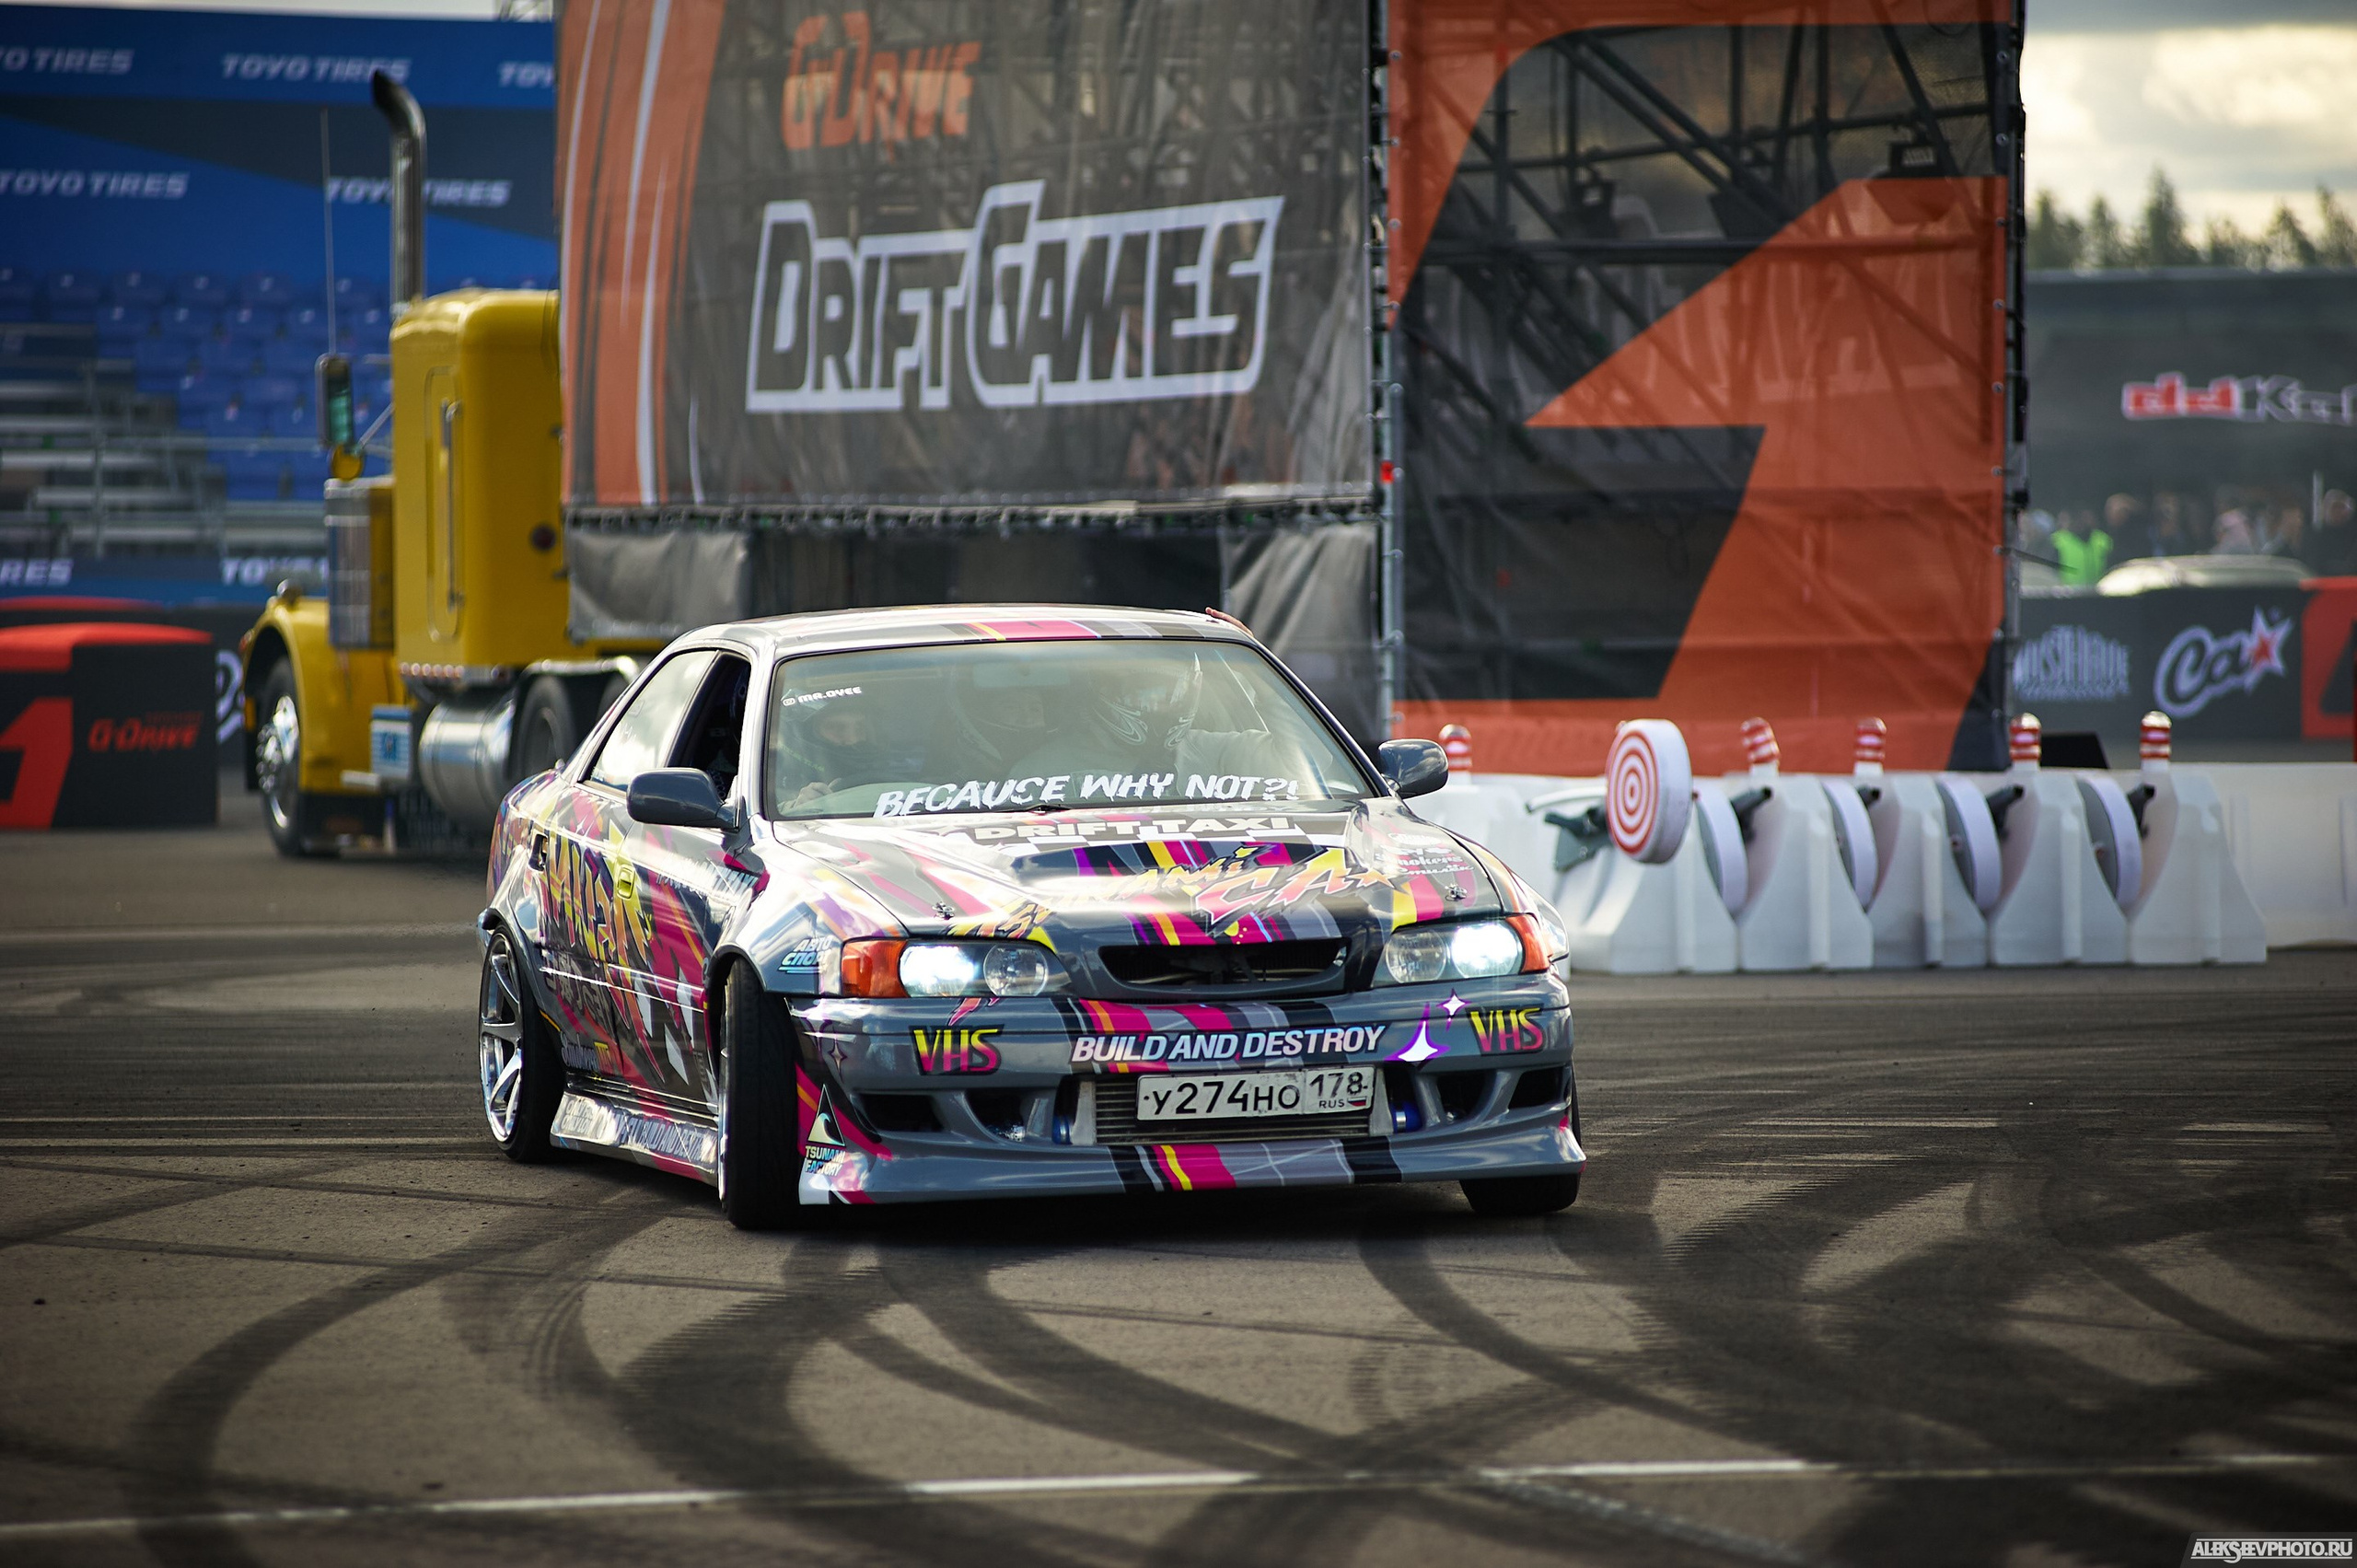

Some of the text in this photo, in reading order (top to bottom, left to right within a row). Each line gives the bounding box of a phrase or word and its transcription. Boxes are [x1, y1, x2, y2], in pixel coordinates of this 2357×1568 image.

[33, 48, 135, 75] TIRES
[222, 53, 310, 81] TOYO
[89, 170, 190, 200] TIRES
[873, 772, 1300, 817] BECAUSE WHY NOT?!
[975, 817, 1299, 841] DRIFT TAXI
[1072, 1025, 1386, 1062] BUILD AND DESTROY
[1470, 1007, 1543, 1052] VHS
[913, 1028, 999, 1072] VHS
[1153, 1080, 1301, 1115] У274НО
[1309, 1072, 1364, 1097] 178
[1318, 1099, 1345, 1109] RUS
[806, 1145, 846, 1164] TSUNAMI
[806, 1160, 842, 1177] FACTORY
